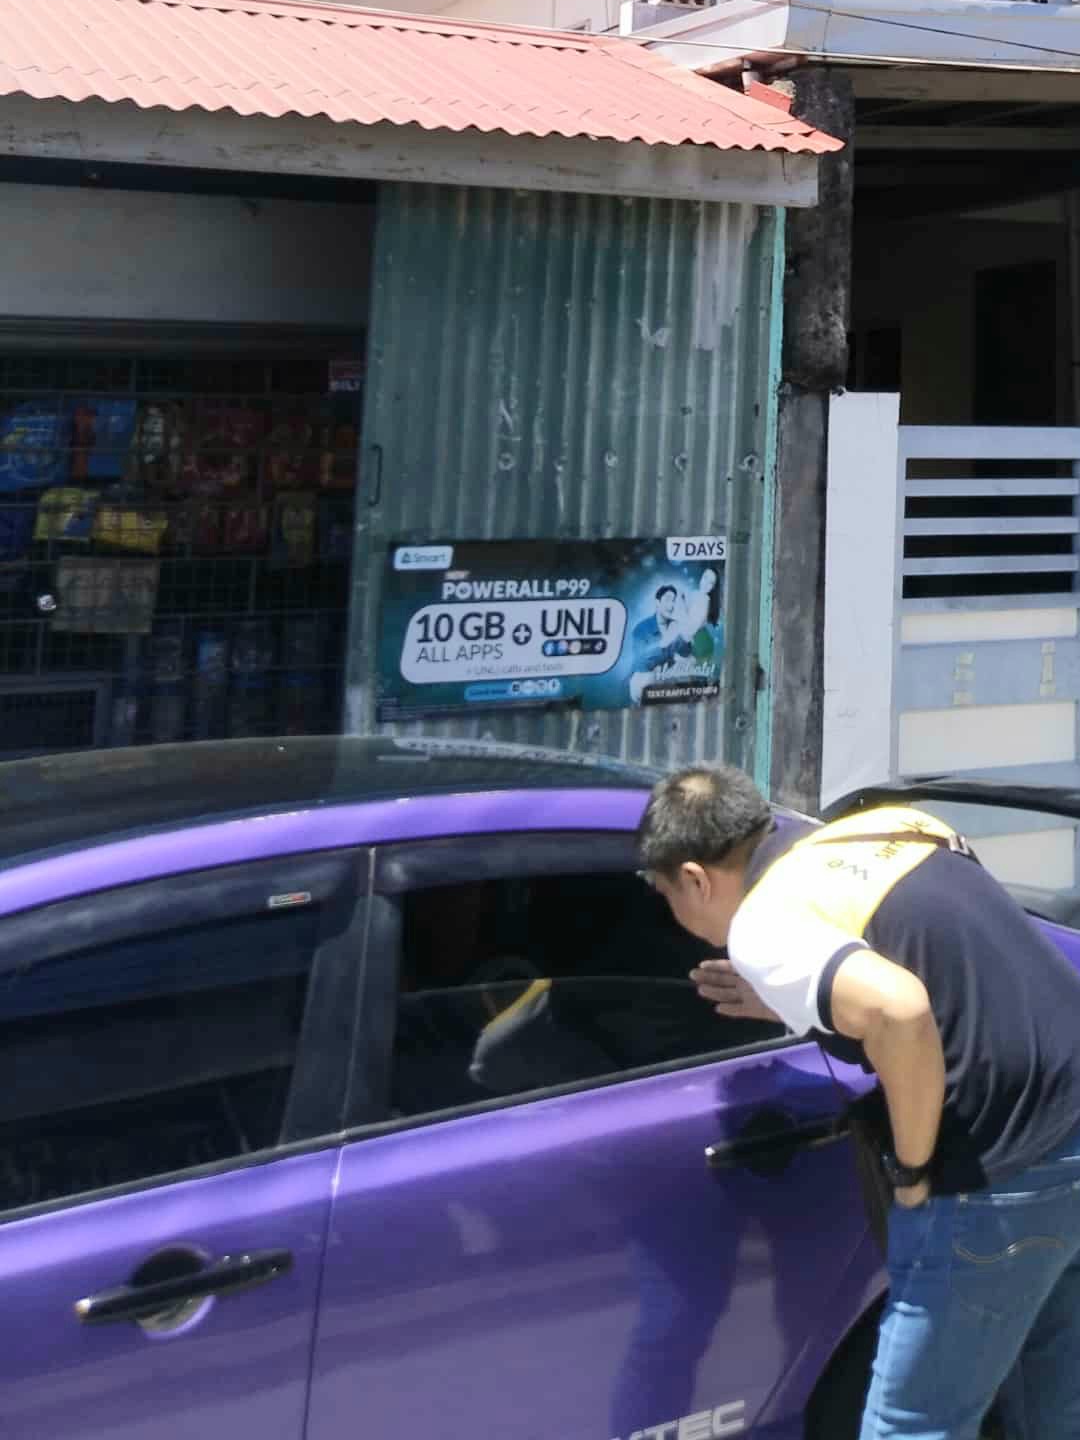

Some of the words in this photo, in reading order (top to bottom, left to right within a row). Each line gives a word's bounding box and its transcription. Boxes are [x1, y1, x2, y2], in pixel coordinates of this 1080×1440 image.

[672, 542, 681, 557] 7
[685, 541, 725, 556] DAYS
[442, 579, 554, 600] POWERALL
[541, 607, 611, 637] UNLI
[415, 645, 450, 663] ALL
[455, 643, 504, 661] APPS
[610, 1399, 744, 1440] TEC
